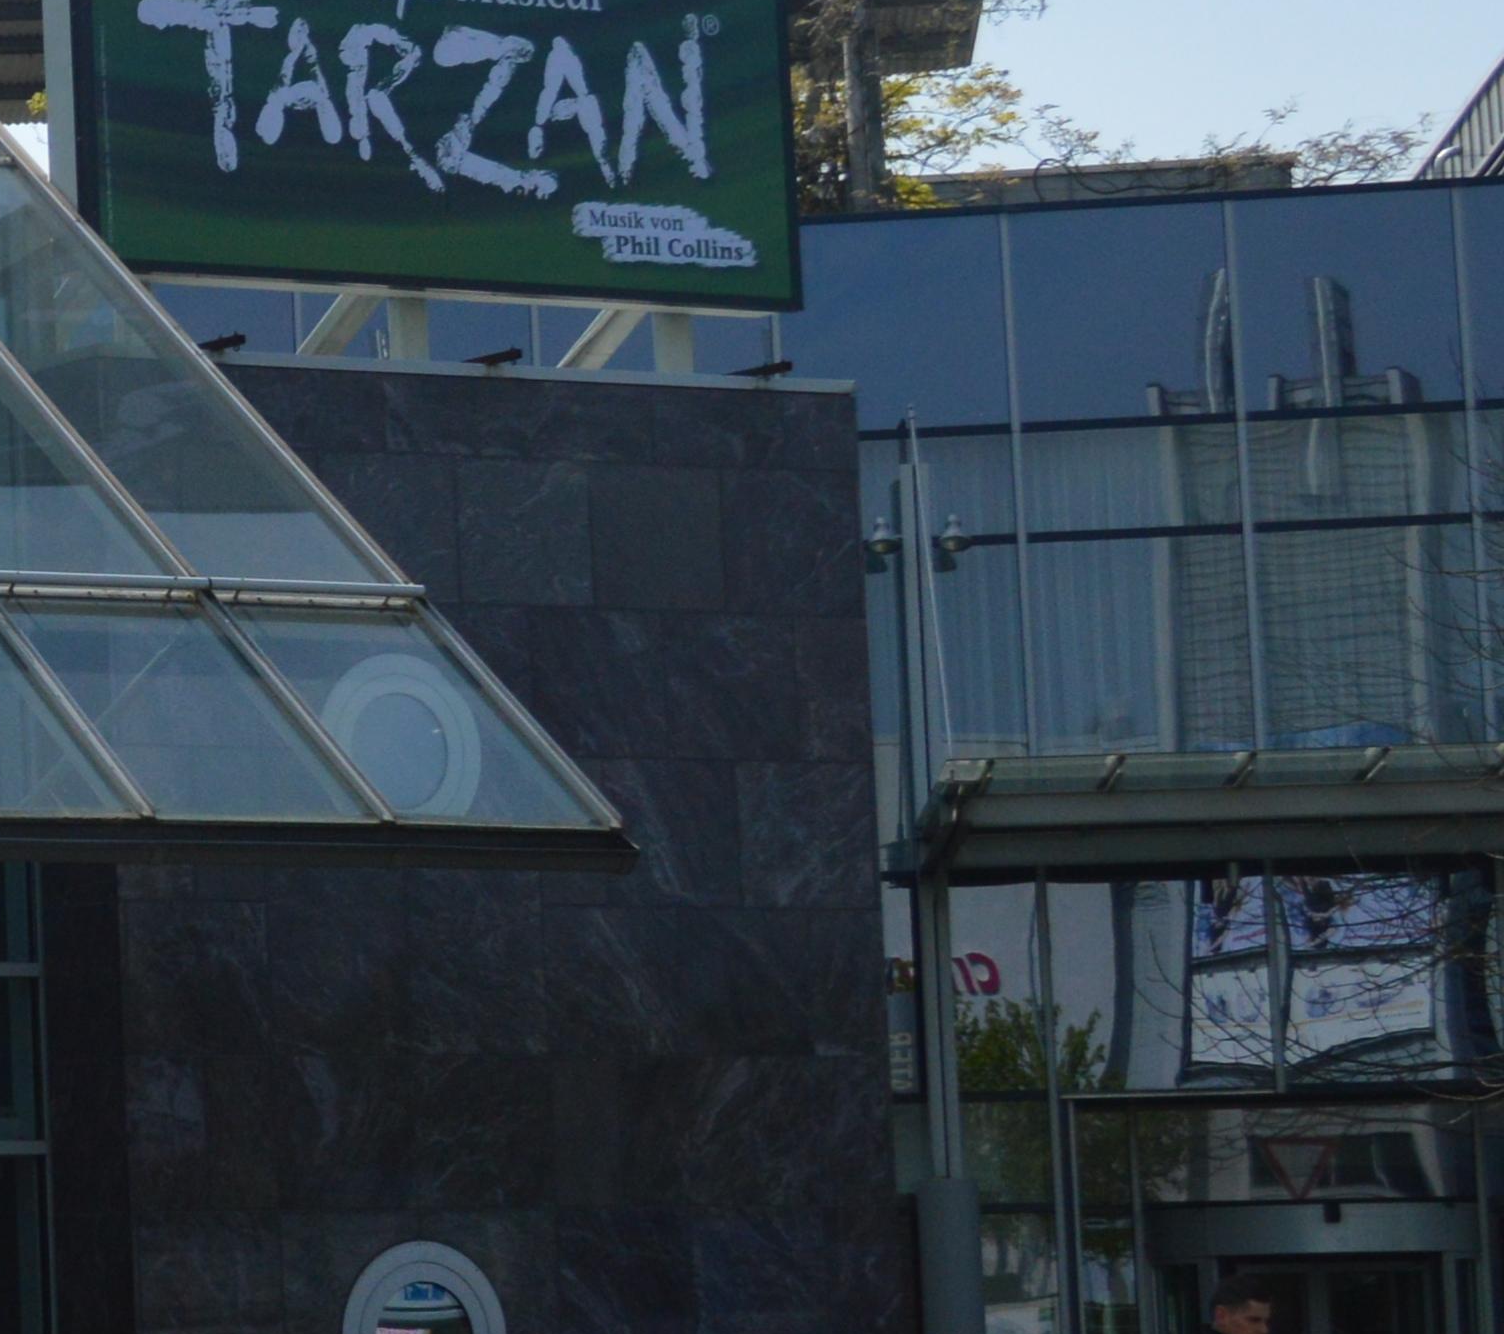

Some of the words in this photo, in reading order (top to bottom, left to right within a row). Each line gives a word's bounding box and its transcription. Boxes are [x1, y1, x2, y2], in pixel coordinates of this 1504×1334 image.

[589, 210, 644, 229] Musik
[651, 217, 684, 231] von
[615, 235, 660, 257] Phil
[668, 238, 745, 261] Collins
